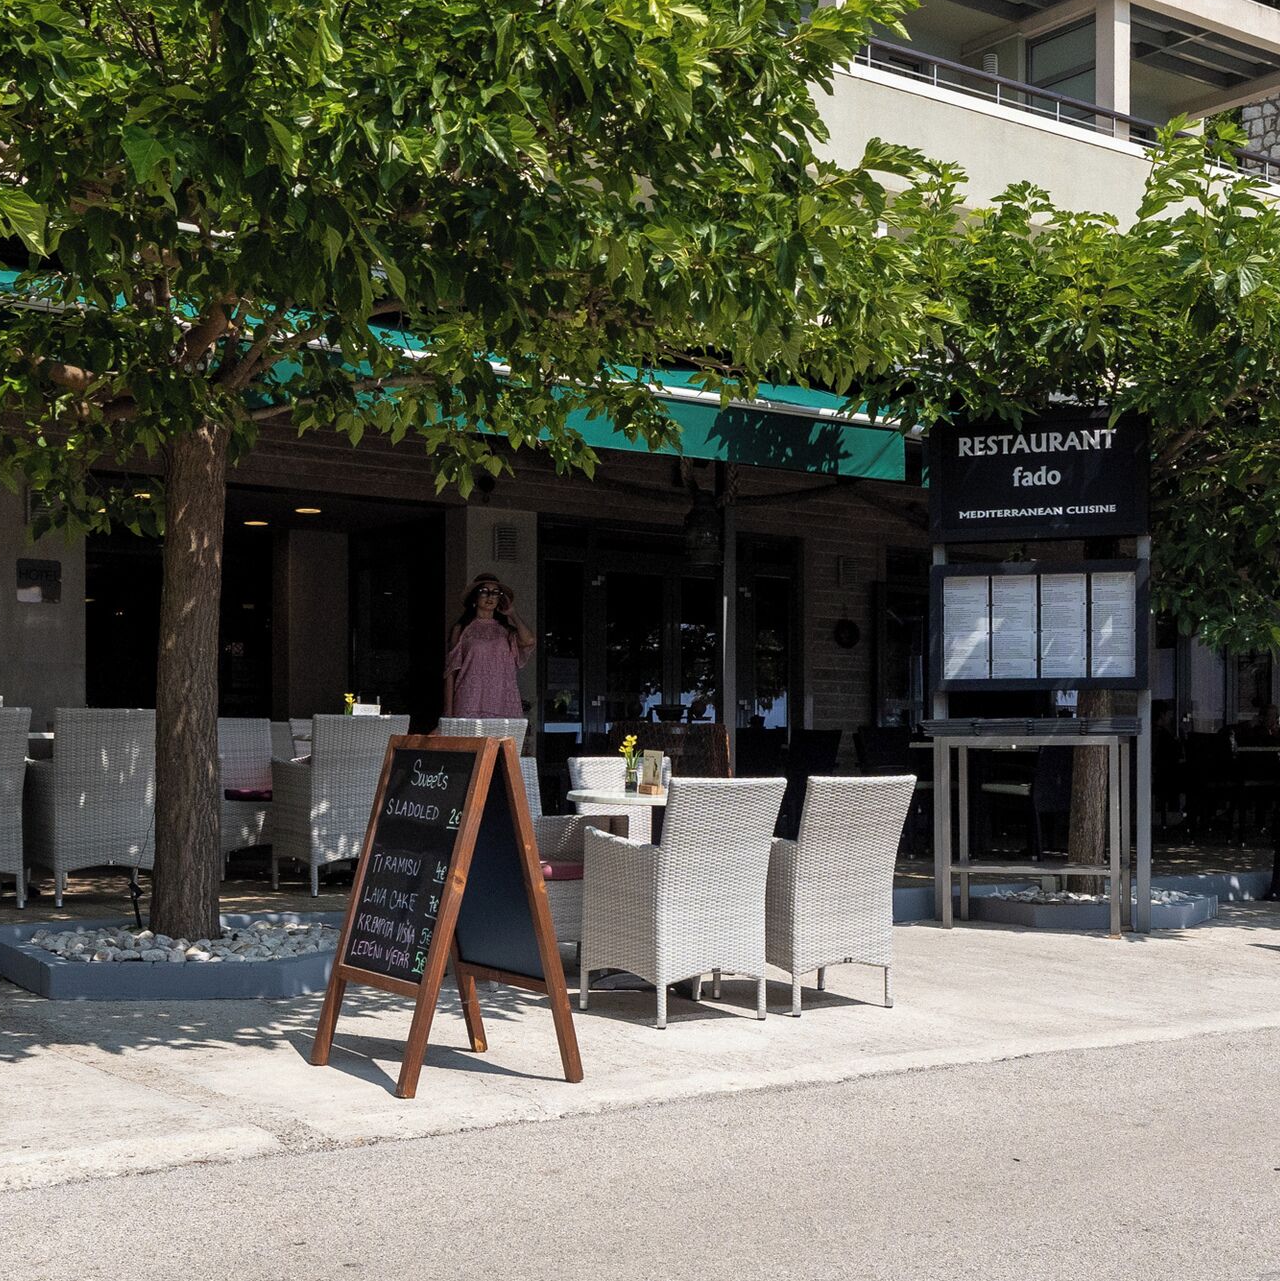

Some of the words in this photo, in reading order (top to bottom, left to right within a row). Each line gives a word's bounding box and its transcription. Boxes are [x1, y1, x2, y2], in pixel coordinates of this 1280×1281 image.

[958, 428, 1117, 457] RESTAURANT
[1013, 466, 1061, 487] fado
[959, 506, 1063, 519] MEDITERRANEAN
[1066, 504, 1117, 515] CUISINE
[411, 759, 448, 790] Sweets
[386, 798, 439, 821] SLADOLED
[448, 809, 462, 825] 2€
[373, 853, 421, 876] TIRAMISU
[435, 861, 447, 880] 4€
[363, 886, 387, 908] LAVA
[389, 890, 419, 912] CAKE
[419, 928, 433, 946] 5€
